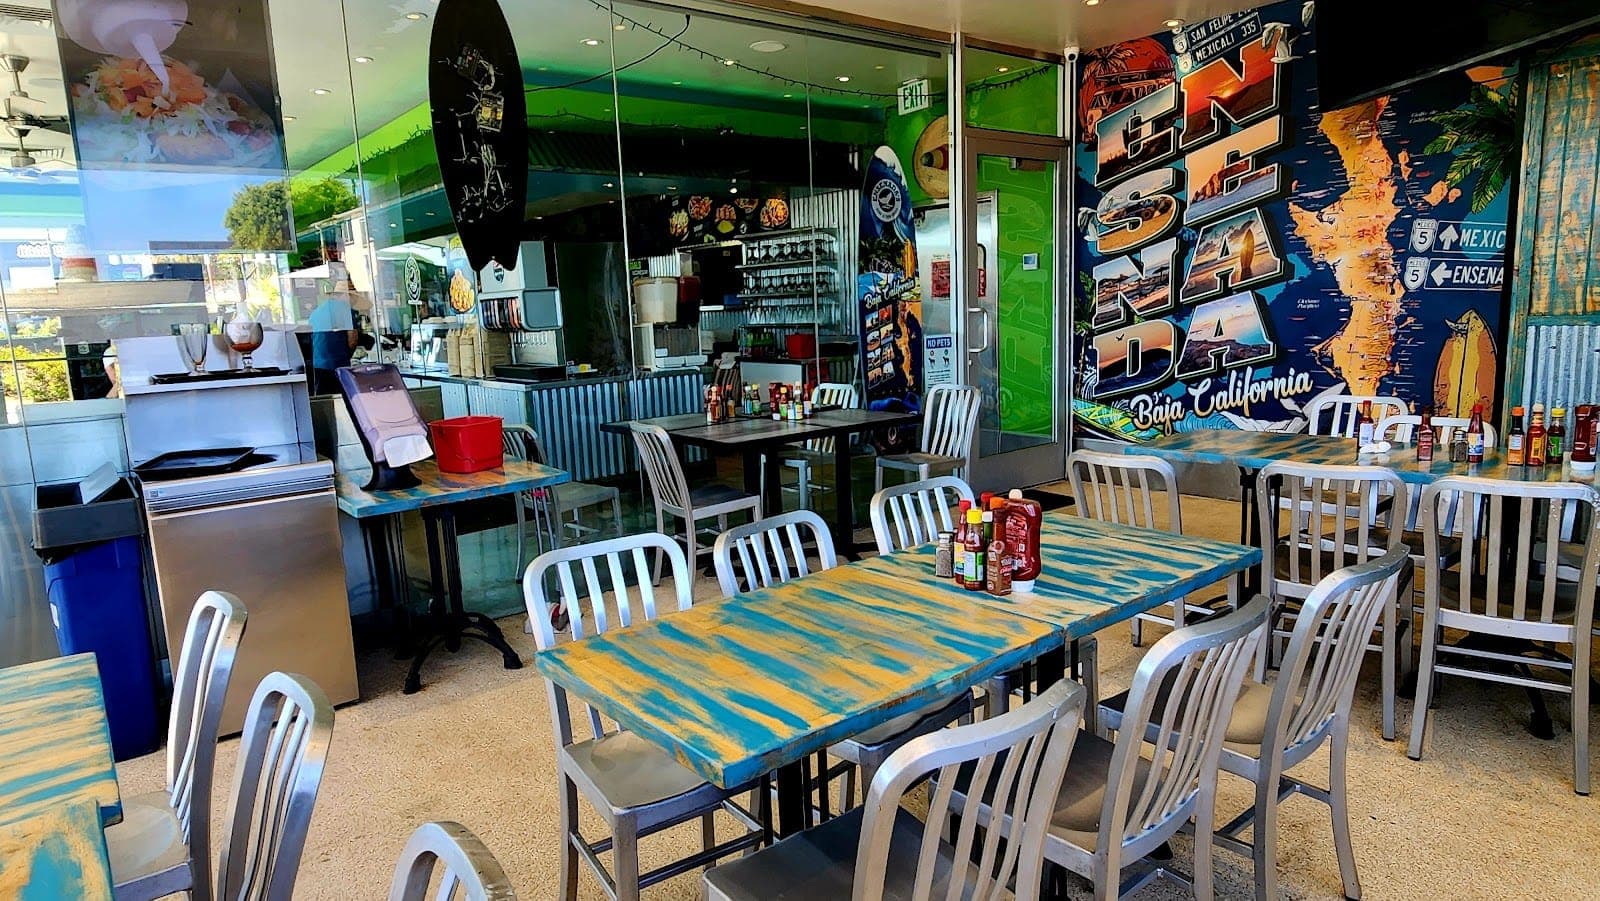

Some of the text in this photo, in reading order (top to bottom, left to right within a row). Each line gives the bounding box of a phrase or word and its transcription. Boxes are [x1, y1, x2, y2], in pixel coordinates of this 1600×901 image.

[1191, 14, 1233, 43] SAN FELIPE
[1196, 21, 1256, 61] MEXICALI 335
[903, 82, 924, 110] EXIT
[1418, 231, 1428, 245] 5
[1460, 228, 1506, 249] MEXIC
[1410, 269, 1419, 282] 5
[1452, 265, 1505, 285] ENSENA
[864, 294, 882, 309] Baja
[883, 279, 915, 301] California
[927, 338, 951, 348] NO PETS
[1130, 365, 1313, 437] Baja California
